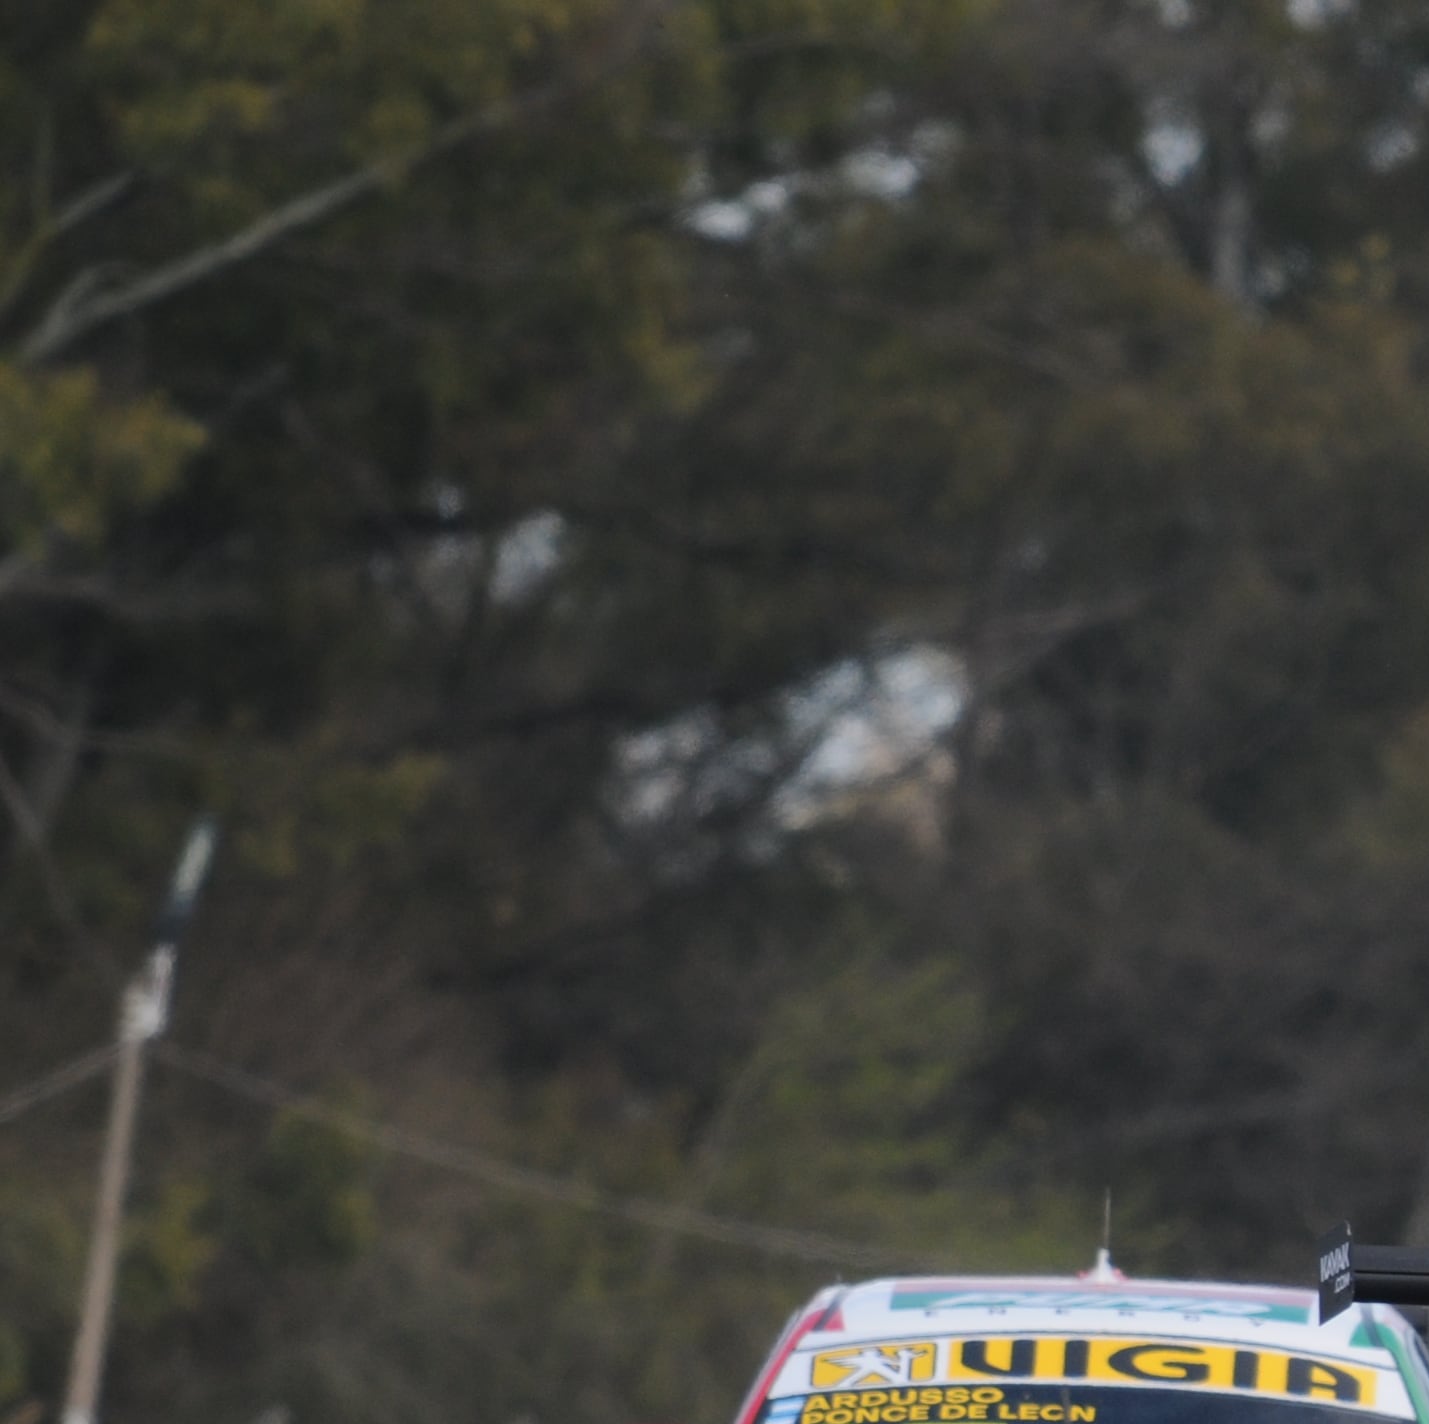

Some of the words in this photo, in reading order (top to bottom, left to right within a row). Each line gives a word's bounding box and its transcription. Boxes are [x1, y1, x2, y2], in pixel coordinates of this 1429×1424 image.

[803, 1387, 1004, 1412] ARDUSSO
[941, 1403, 990, 1422] DE
[999, 1402, 1096, 1424] LEON
